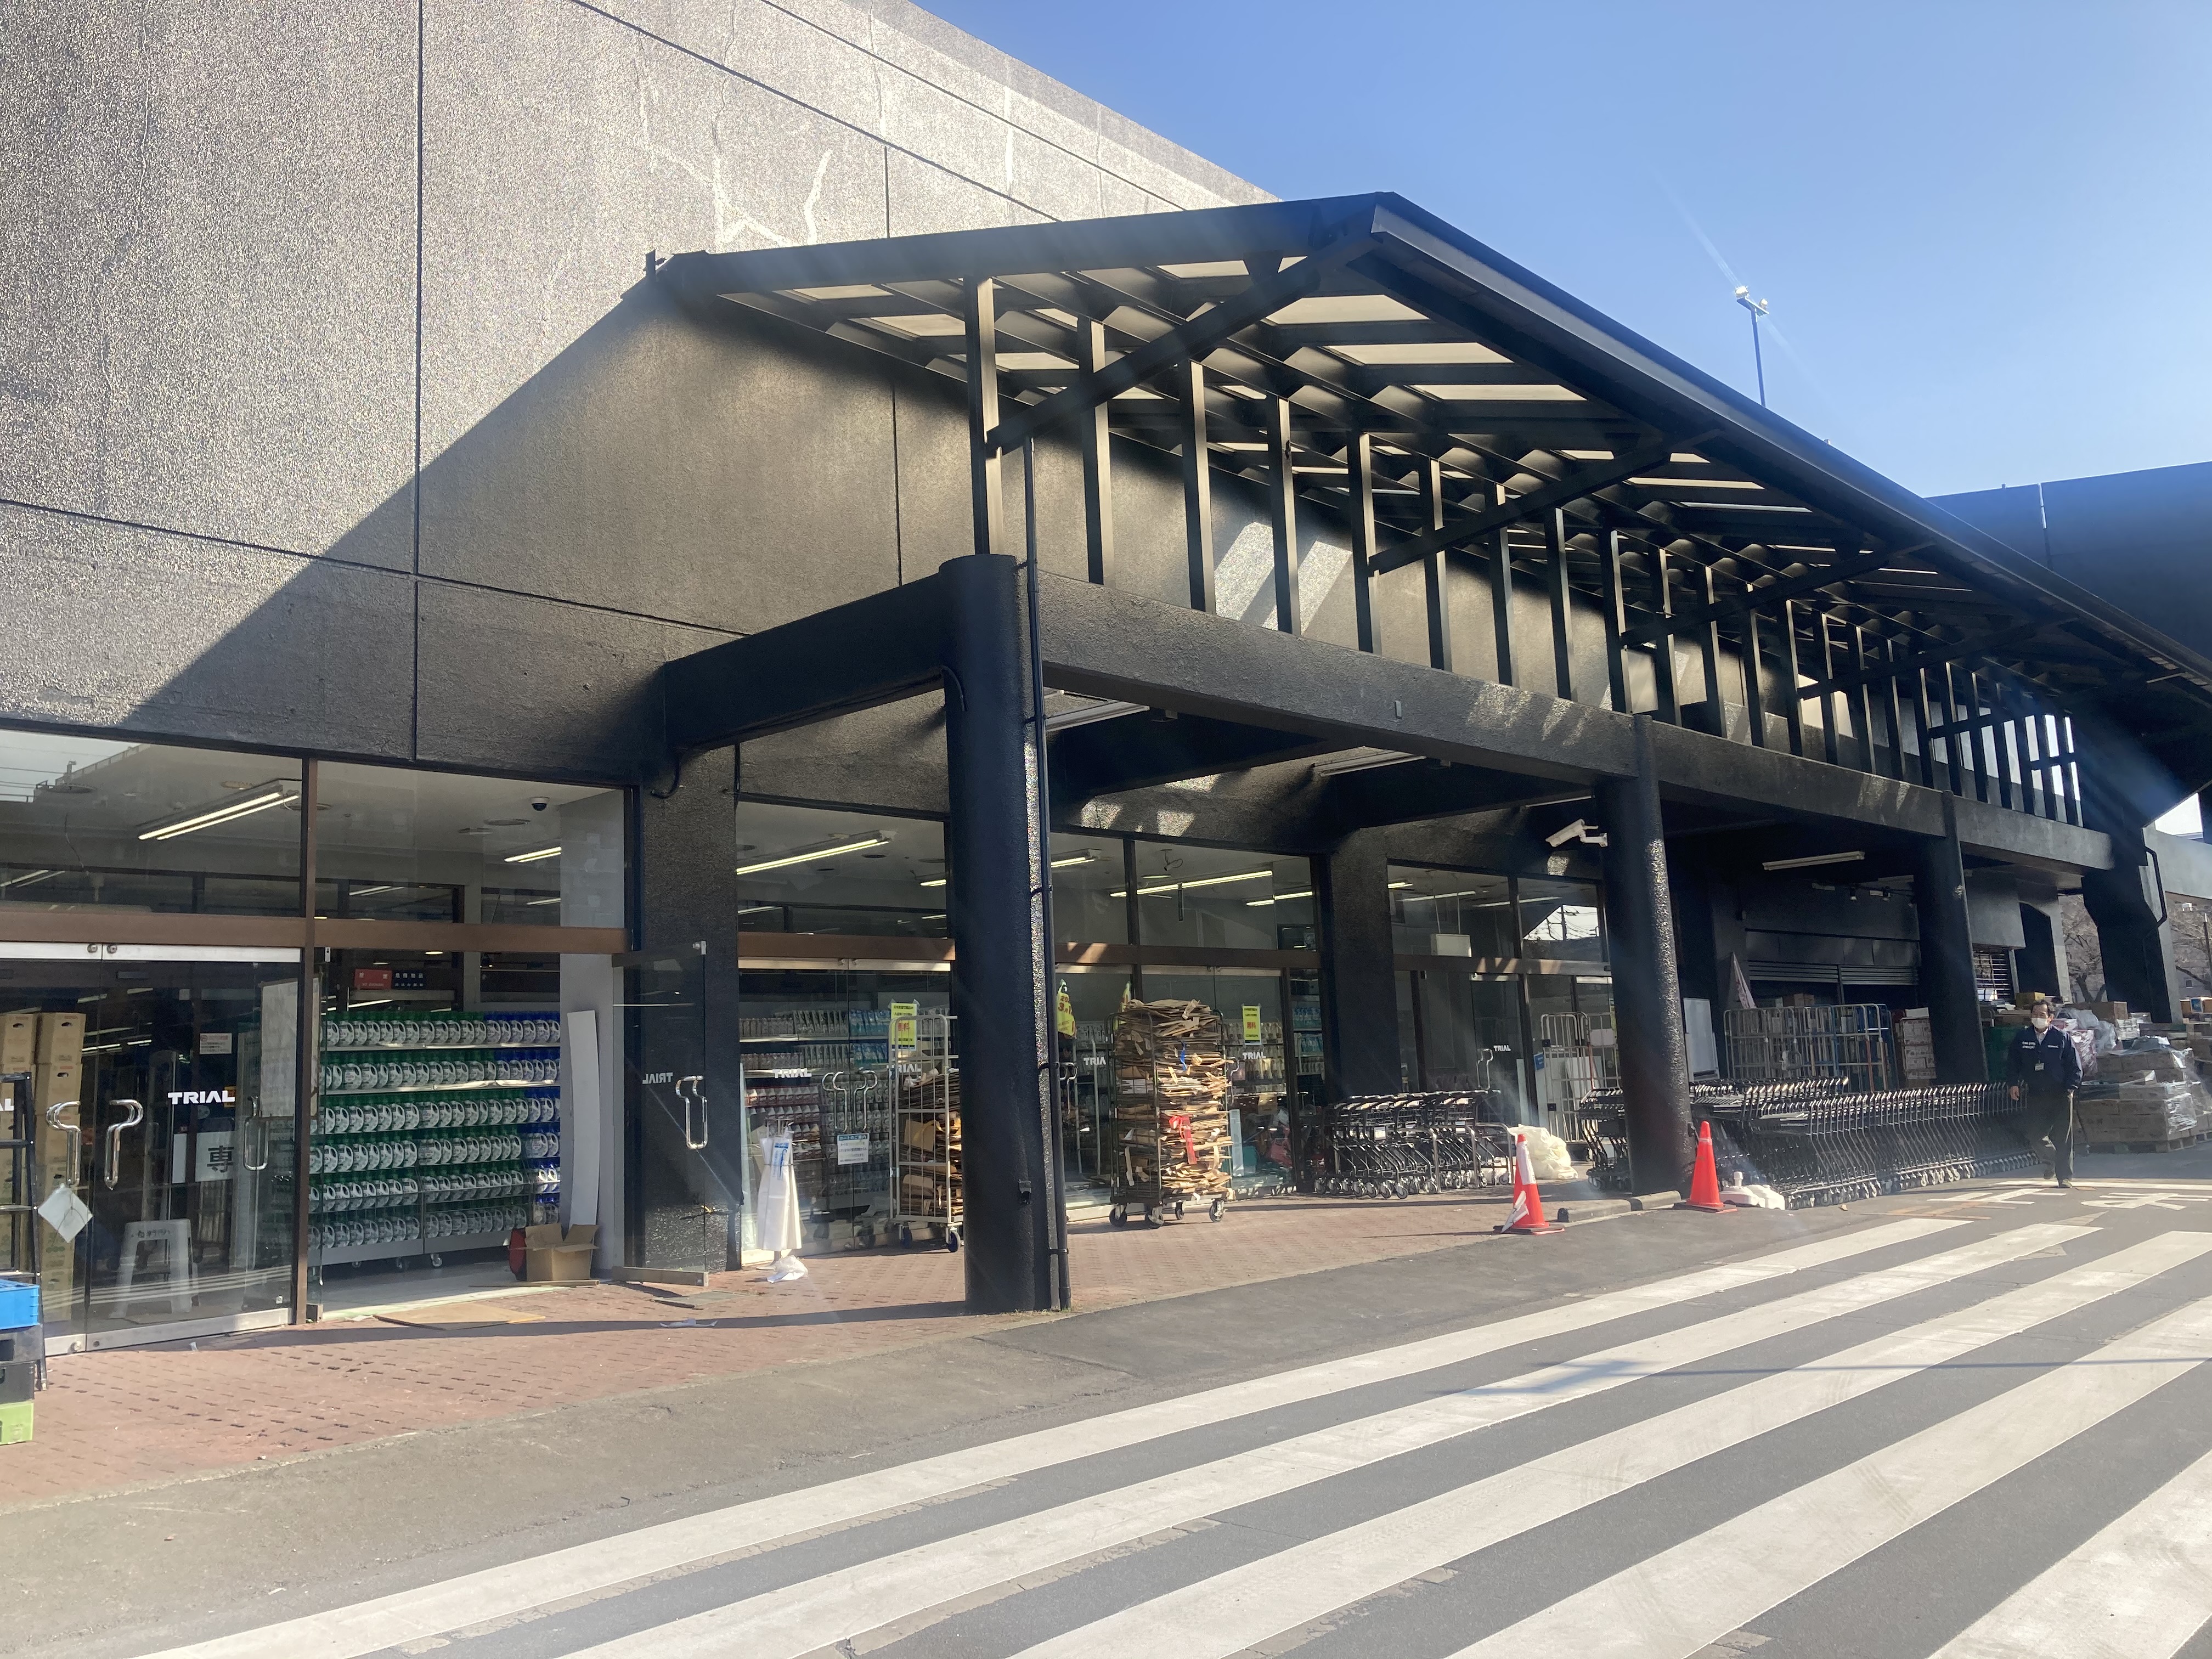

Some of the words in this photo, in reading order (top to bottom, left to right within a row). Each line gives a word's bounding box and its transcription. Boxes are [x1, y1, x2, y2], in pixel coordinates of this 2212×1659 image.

[773, 1068, 811, 1079] TRIAL
[168, 1091, 235, 1104] TRIAL
[207, 1146, 234, 1173] 専
